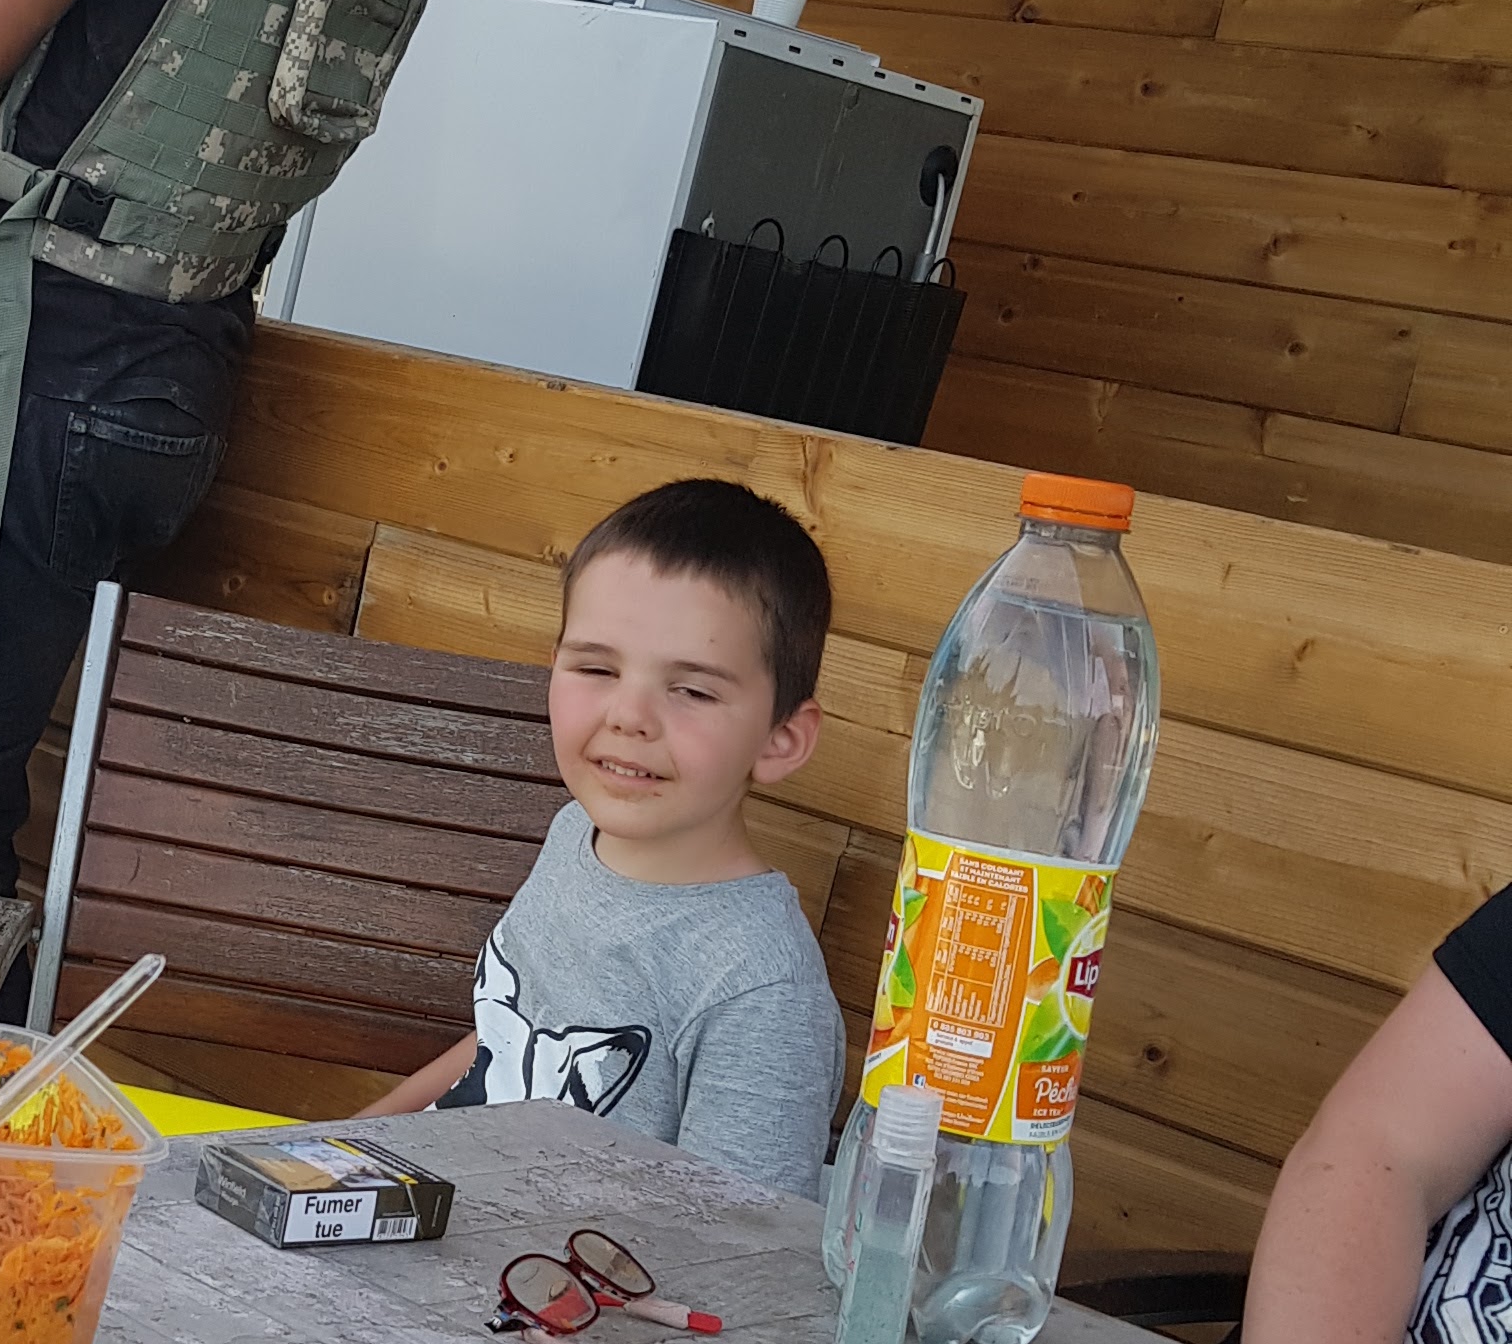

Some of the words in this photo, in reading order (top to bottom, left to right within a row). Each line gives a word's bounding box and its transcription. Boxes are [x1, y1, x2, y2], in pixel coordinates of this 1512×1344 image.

[959, 857, 980, 868] SANS
[981, 863, 1025, 877] COLORANT
[969, 868, 1021, 884] MAINTENANT
[304, 1195, 363, 1216] Fumer
[315, 1220, 343, 1239] tue
